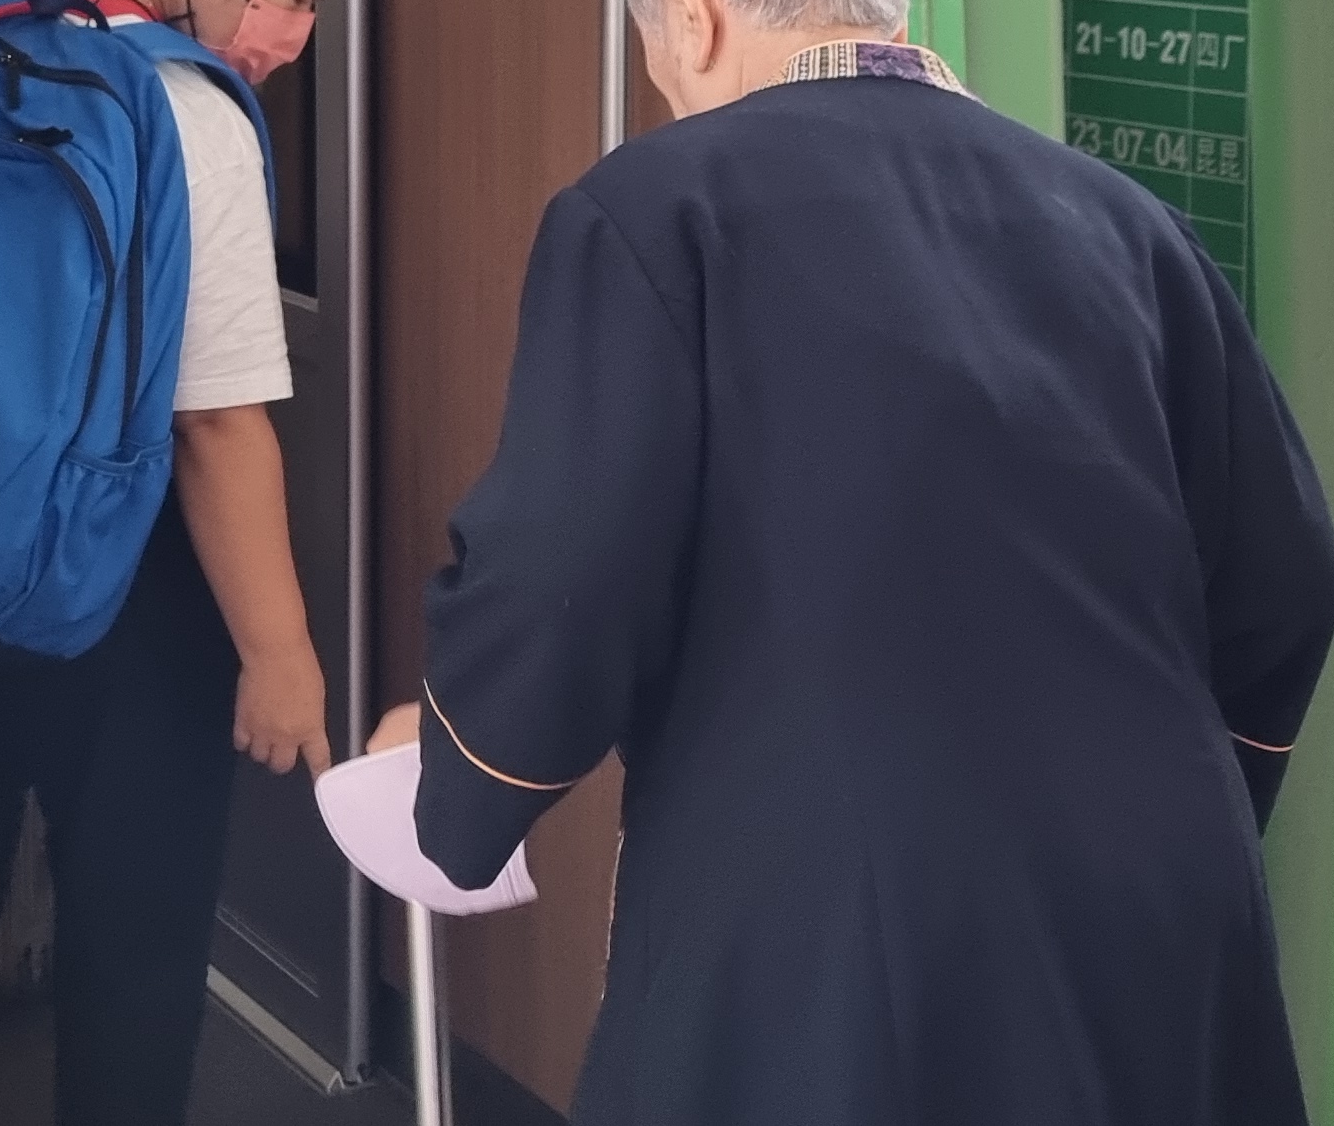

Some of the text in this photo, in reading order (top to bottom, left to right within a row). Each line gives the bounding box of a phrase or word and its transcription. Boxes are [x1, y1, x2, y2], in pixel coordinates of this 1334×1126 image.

[1075, 21, 1246, 70] 21-10-27 四厂
[1071, 119, 1187, 170] 23-07-04
